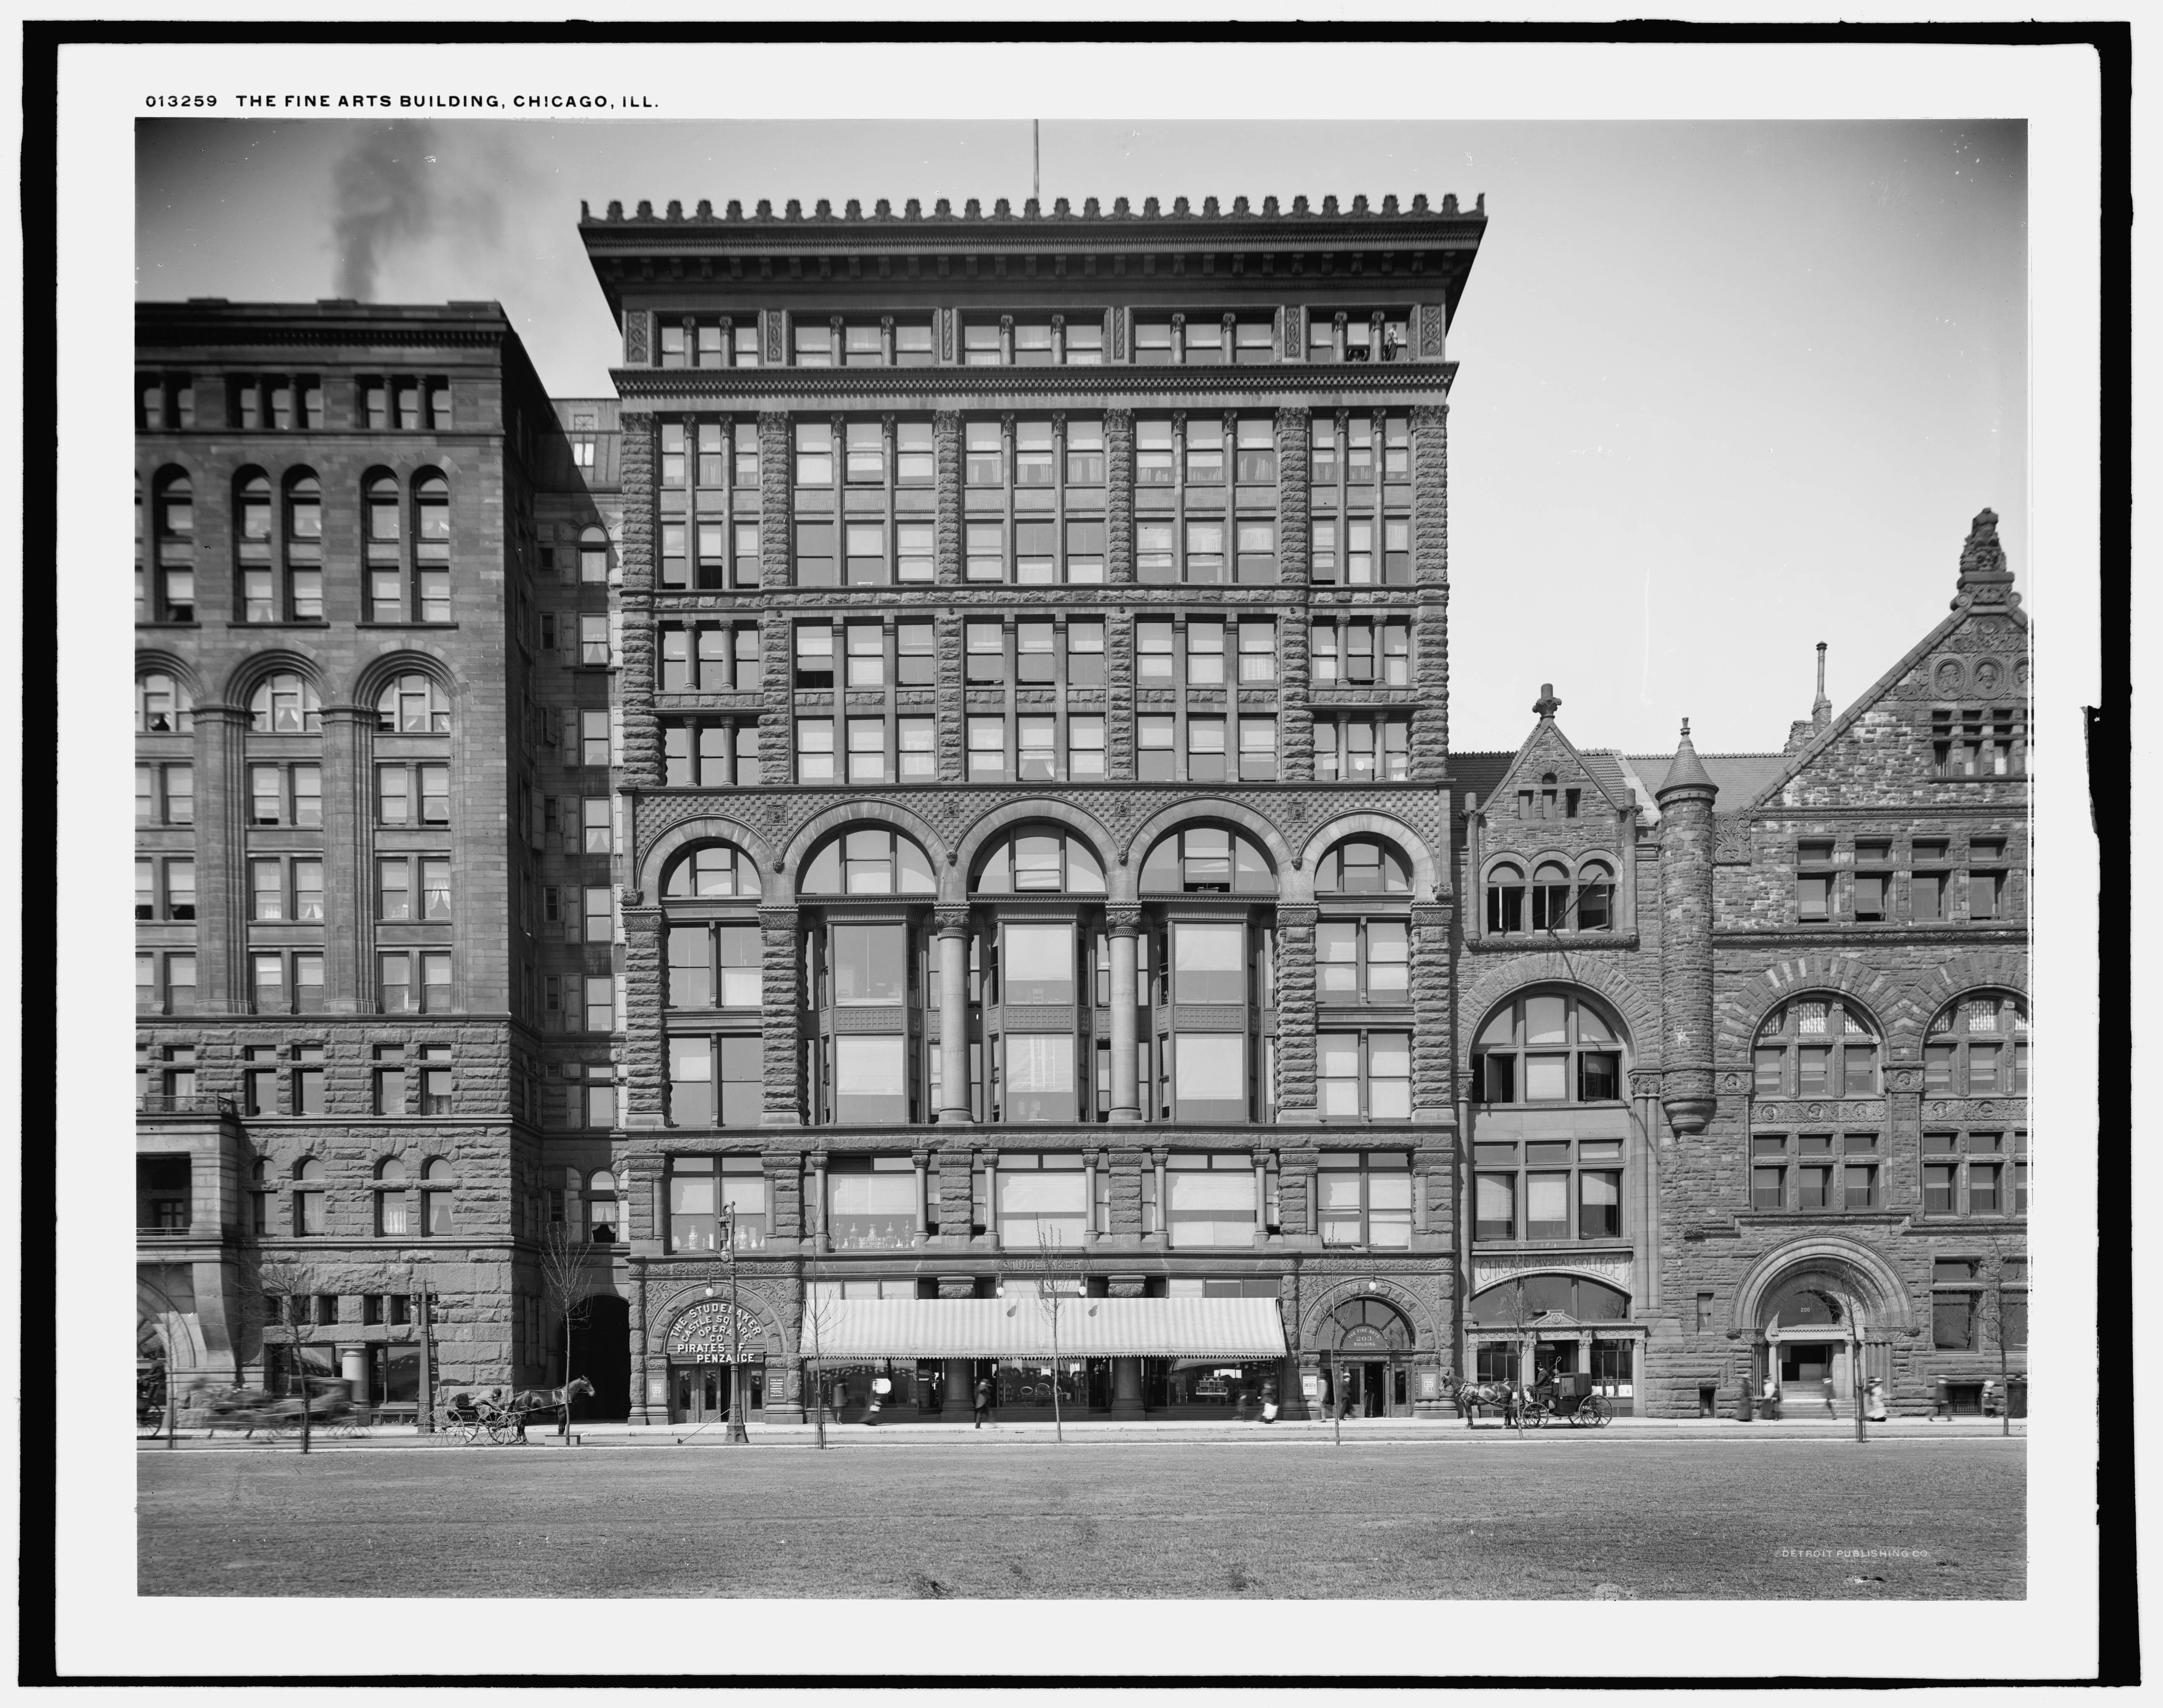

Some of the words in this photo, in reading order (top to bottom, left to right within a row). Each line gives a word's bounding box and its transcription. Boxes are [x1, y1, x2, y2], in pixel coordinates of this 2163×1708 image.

[1479, 1260, 1531, 1282] CHICAGO
[670, 1316, 688, 1337] THE
[681, 1315, 712, 1342] CASTLE
[716, 1315, 752, 1341] SQARE
[1369, 1329, 1380, 1339] ARTS
[677, 1343, 725, 1353] PIRATES
